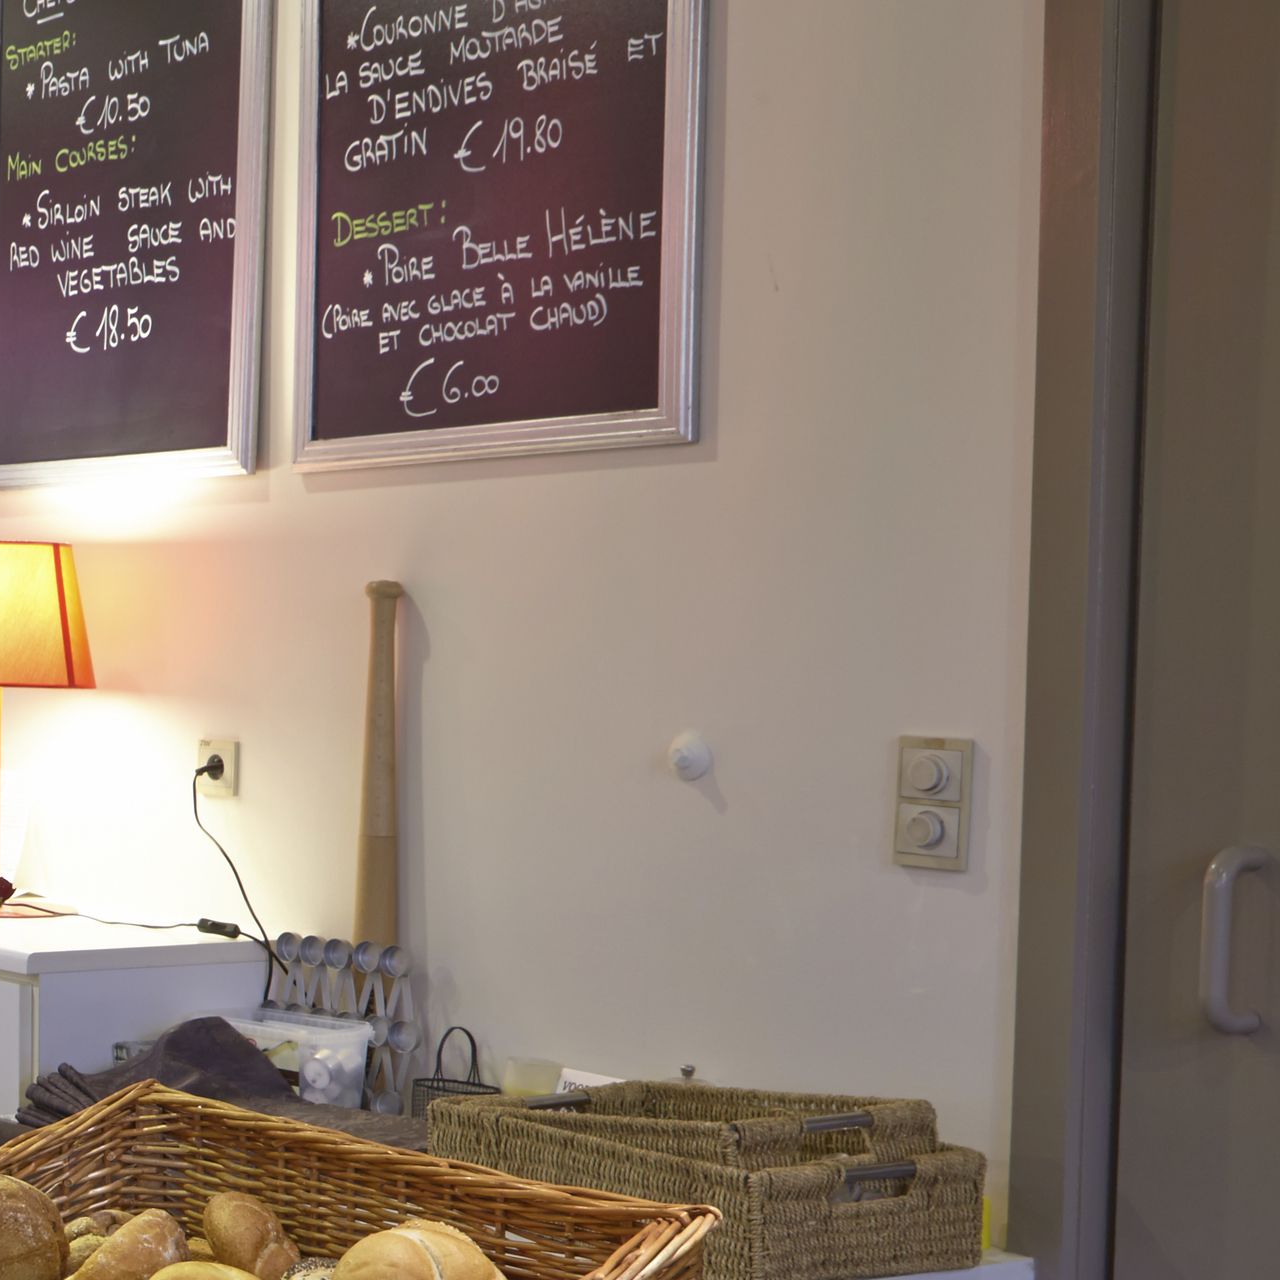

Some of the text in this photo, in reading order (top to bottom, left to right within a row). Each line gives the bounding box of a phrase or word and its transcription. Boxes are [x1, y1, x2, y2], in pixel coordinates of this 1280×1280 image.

[158, 31, 209, 63] TUNA
[325, 16, 564, 100] LA SAUCE MOUTARDE
[627, 32, 664, 62] ET
[118, 181, 172, 211] STEAK
[10, 241, 40, 272] RED
[127, 221, 182, 253] SAUCE
[199, 217, 237, 243] AND
[57, 256, 180, 298] VEGETABLES
[381, 300, 421, 324] AVEC
[427, 286, 487, 316] GLACE
[530, 275, 554, 299] LA
[379, 293, 609, 355] ET CHOCOLAT CHAUD)
